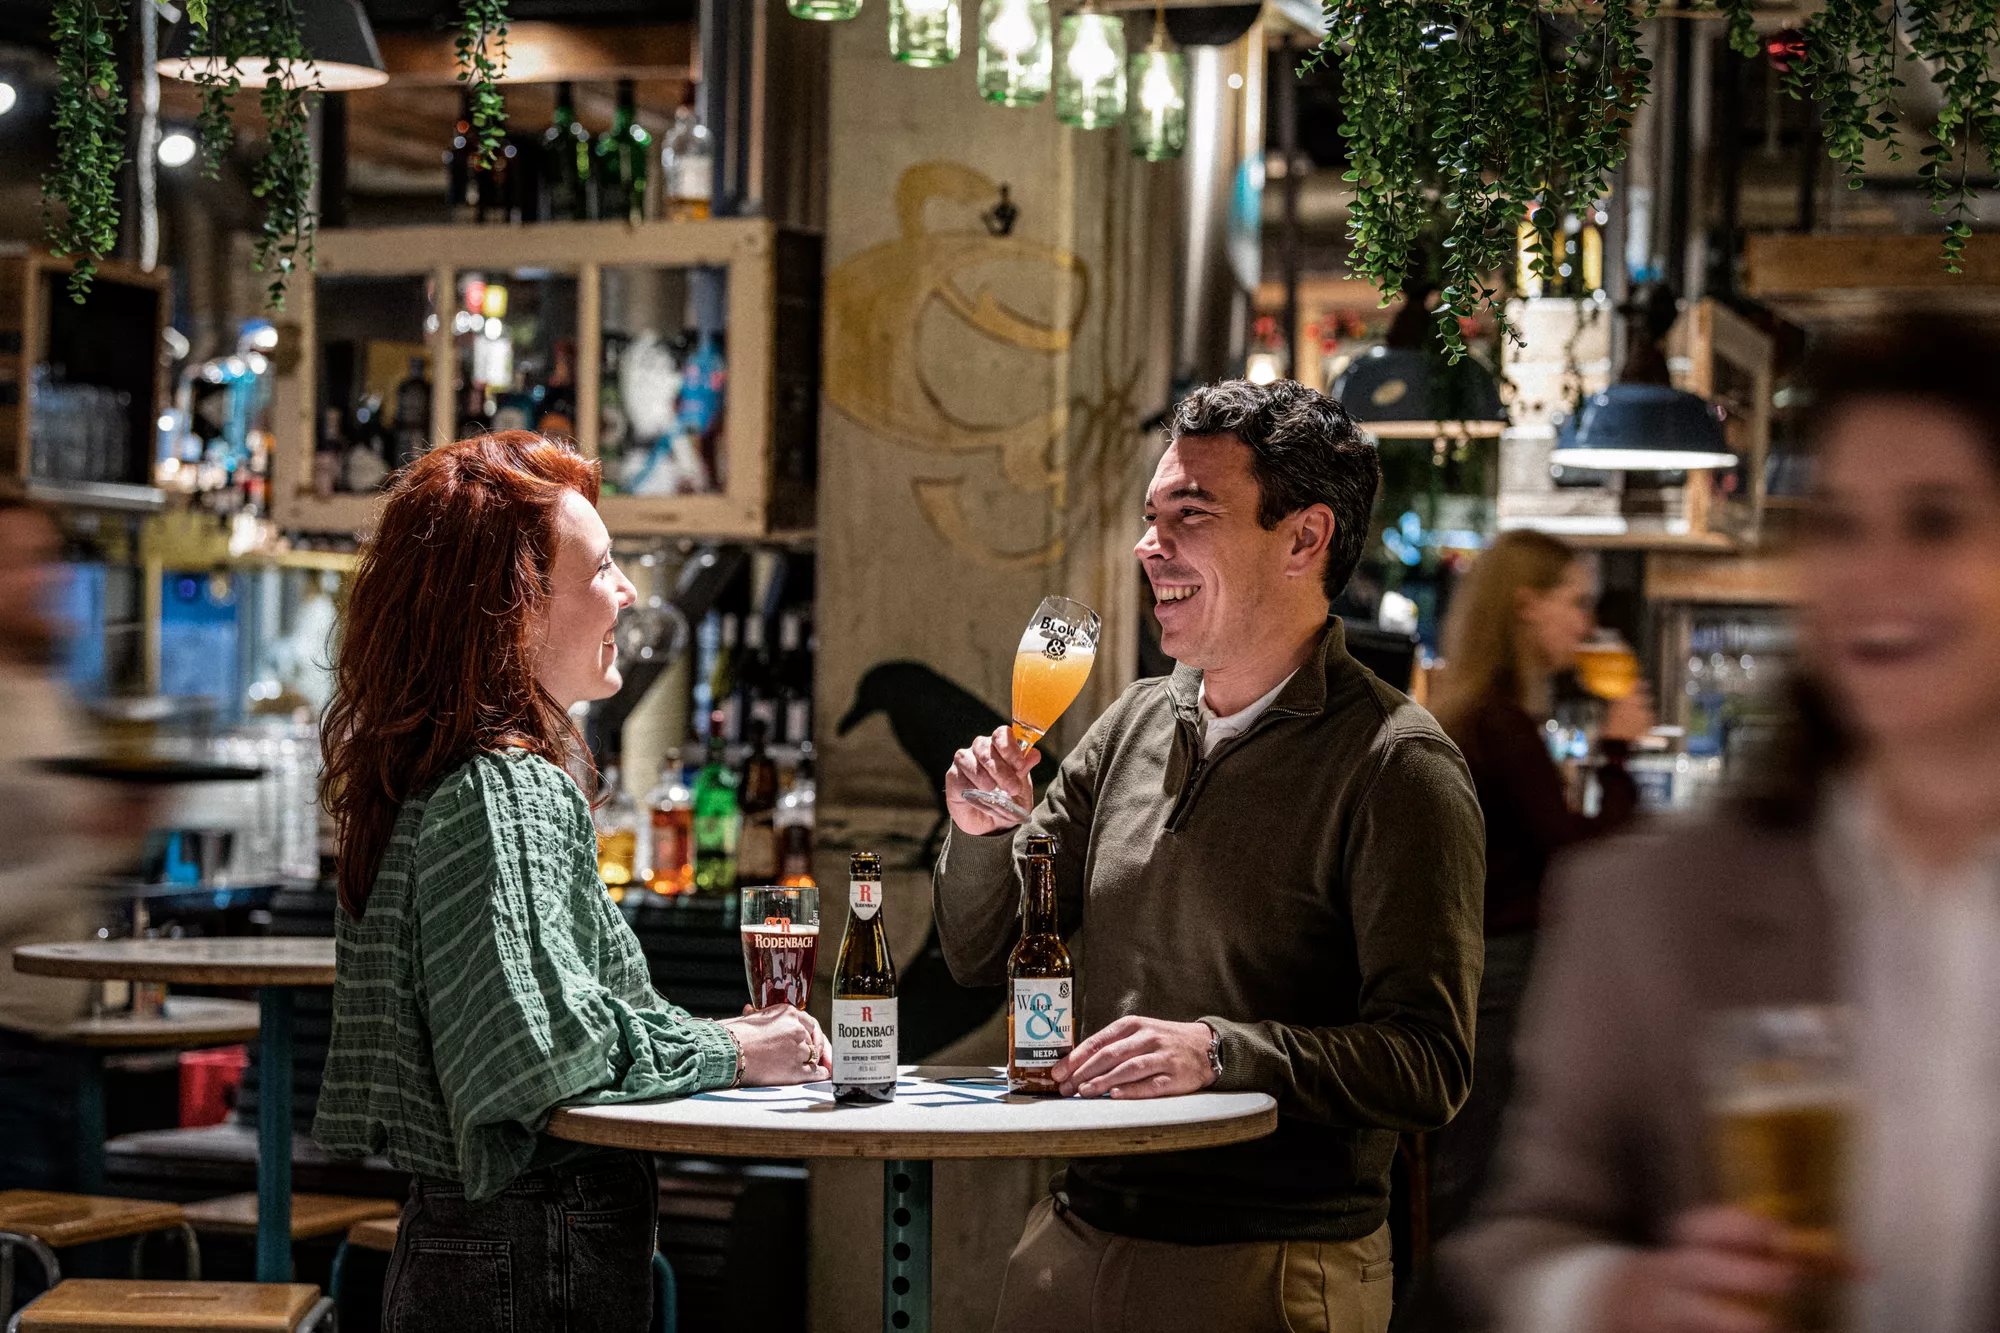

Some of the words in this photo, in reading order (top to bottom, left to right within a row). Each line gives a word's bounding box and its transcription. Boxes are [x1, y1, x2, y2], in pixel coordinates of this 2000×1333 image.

[860, 884, 872, 902] R
[755, 934, 814, 949] RODENBACH
[861, 1006, 872, 1022] R
[838, 1023, 895, 1038] RODENBACH
[852, 1039, 883, 1048] CLASSIC
